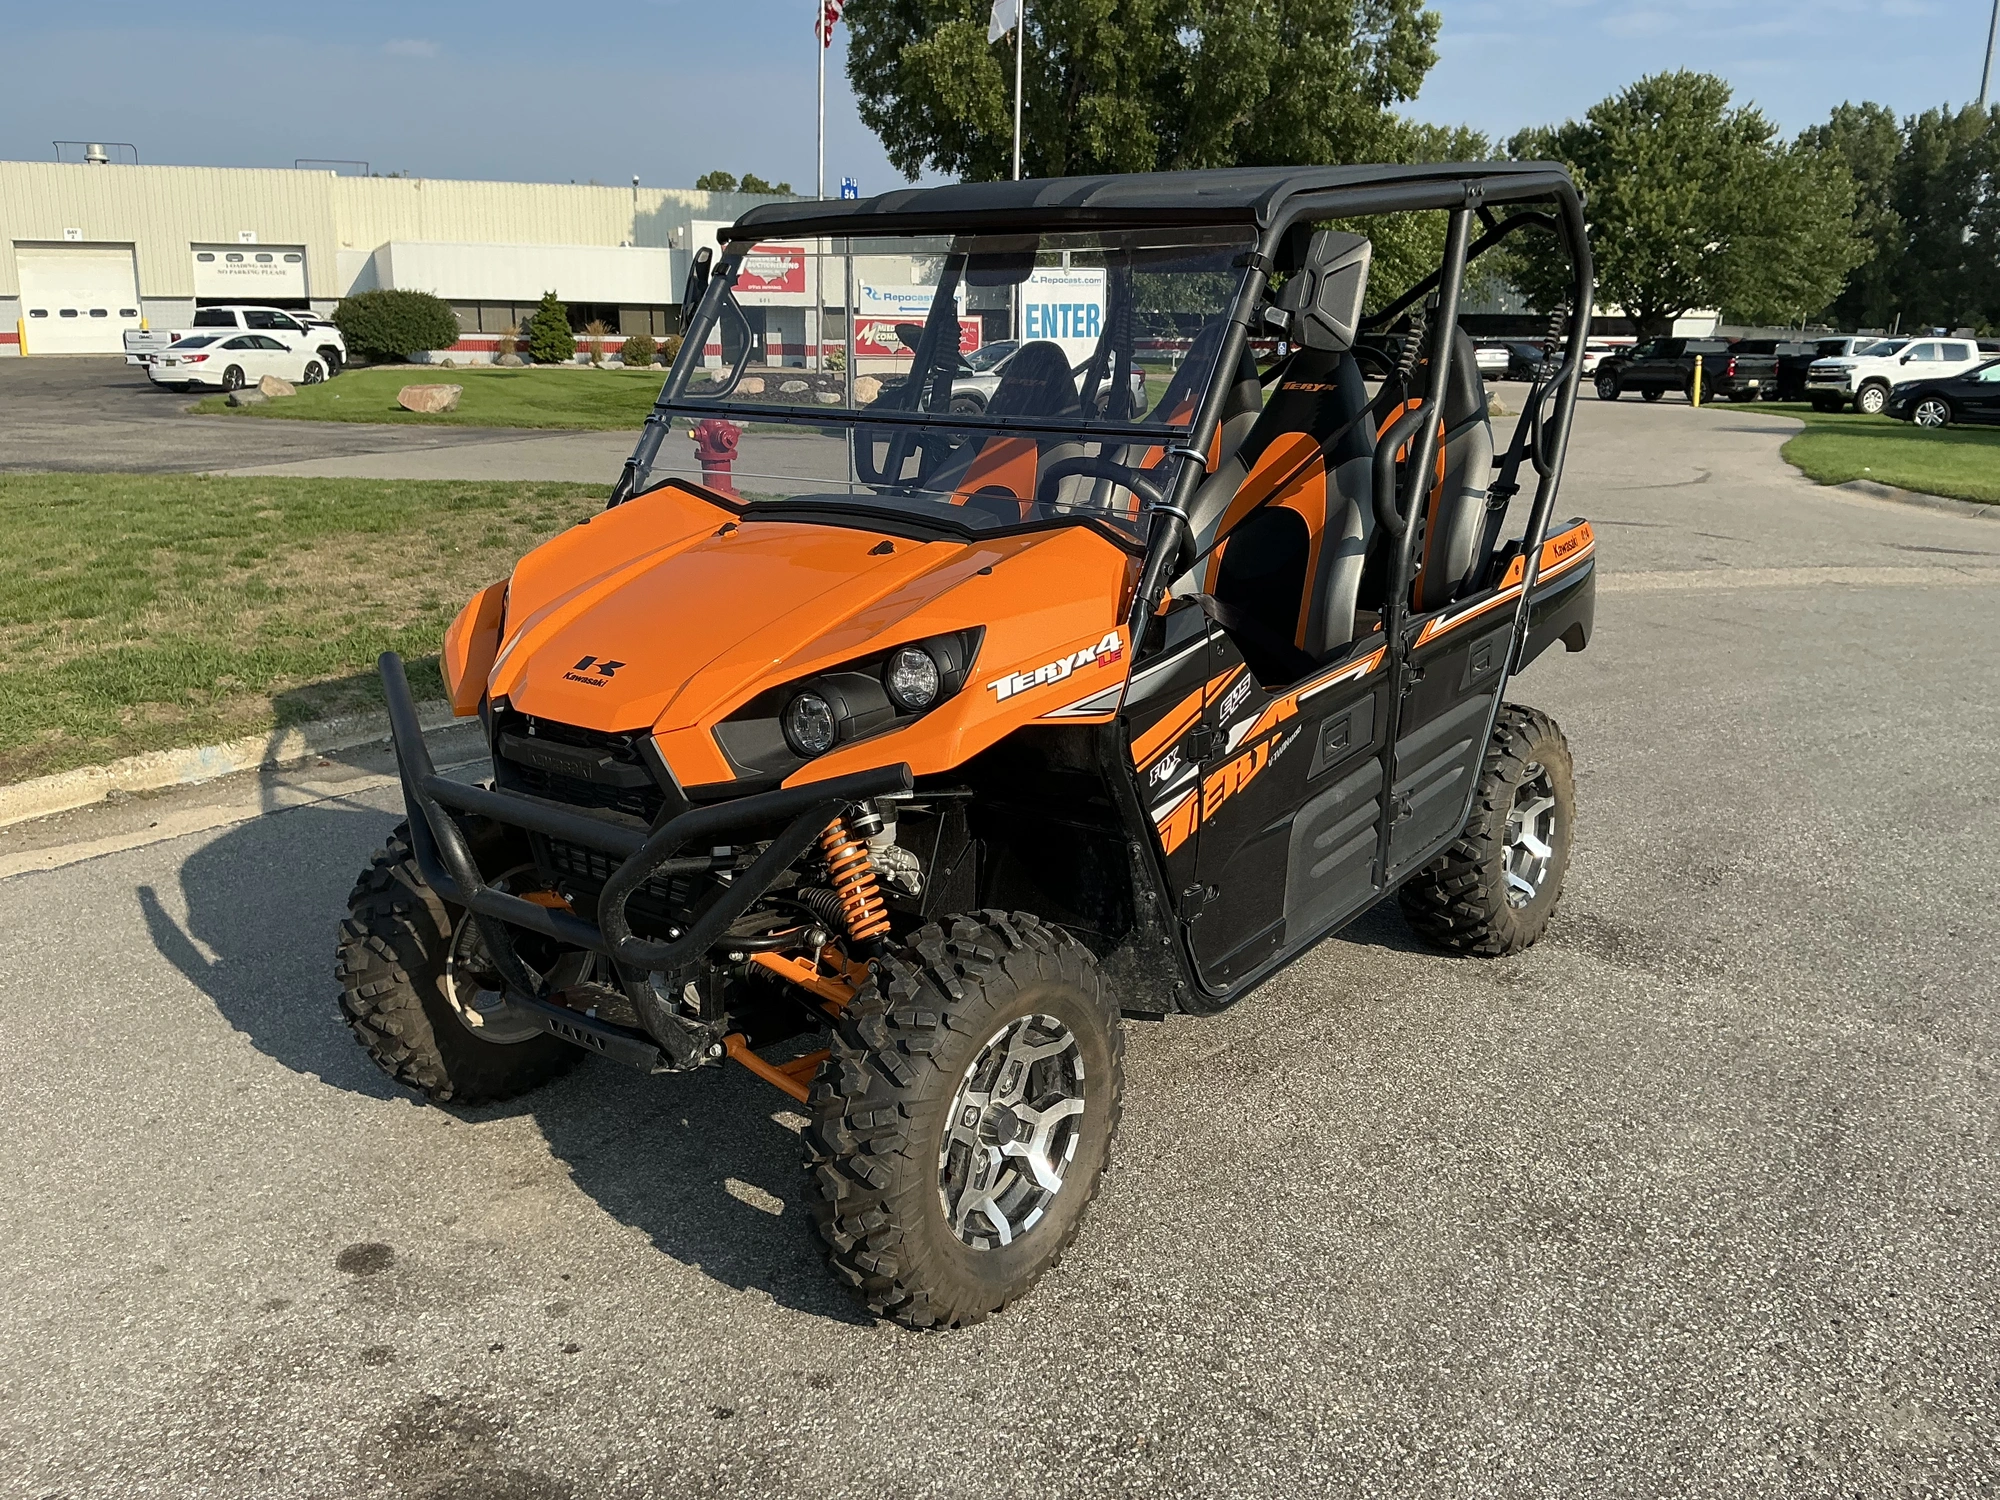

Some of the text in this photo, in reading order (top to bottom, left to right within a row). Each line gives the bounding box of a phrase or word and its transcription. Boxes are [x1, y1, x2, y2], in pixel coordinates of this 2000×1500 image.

[844, 189, 855, 199] 56
[1040, 276, 1102, 285] Repocast.com
[1025, 303, 1100, 339] ENTER
[1553, 534, 1578, 559] Kawasaki
[1097, 647, 1123, 668] LE
[562, 671, 609, 688] Kawasaki
[1149, 745, 1182, 787] FOX
